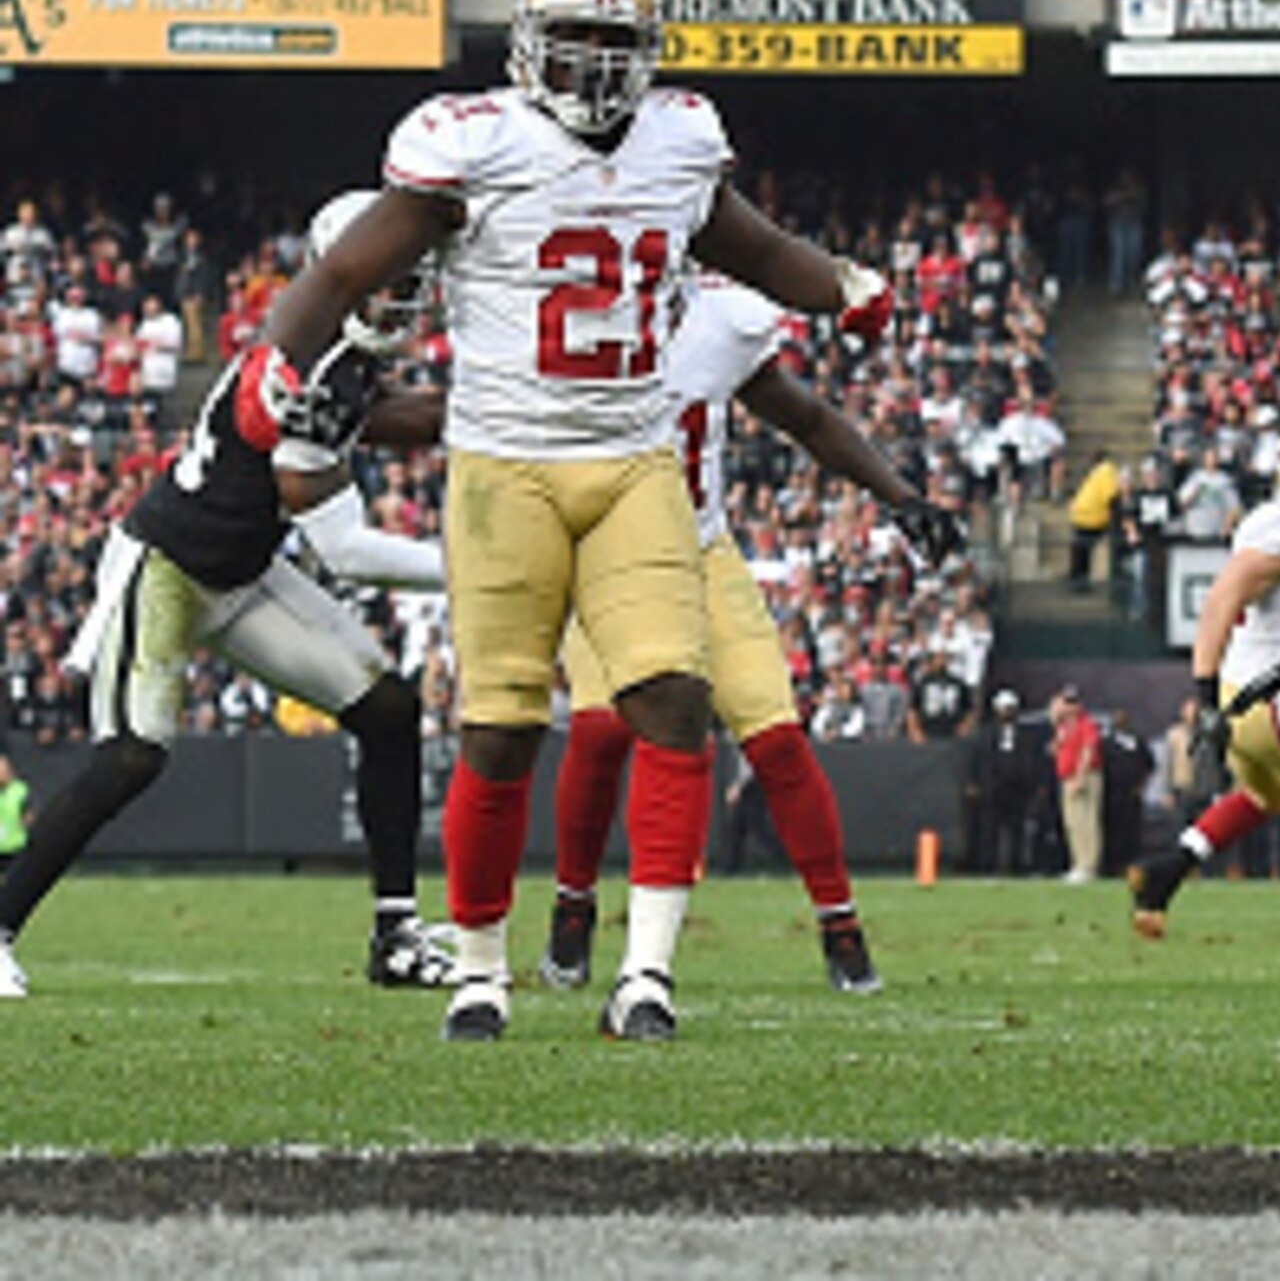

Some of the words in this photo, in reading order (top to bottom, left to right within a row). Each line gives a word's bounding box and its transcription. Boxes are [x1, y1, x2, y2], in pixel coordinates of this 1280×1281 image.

[661, 32, 964, 64] 0-359-BANK
[537, 225, 670, 380] 21
[672, 401, 709, 510] 1
